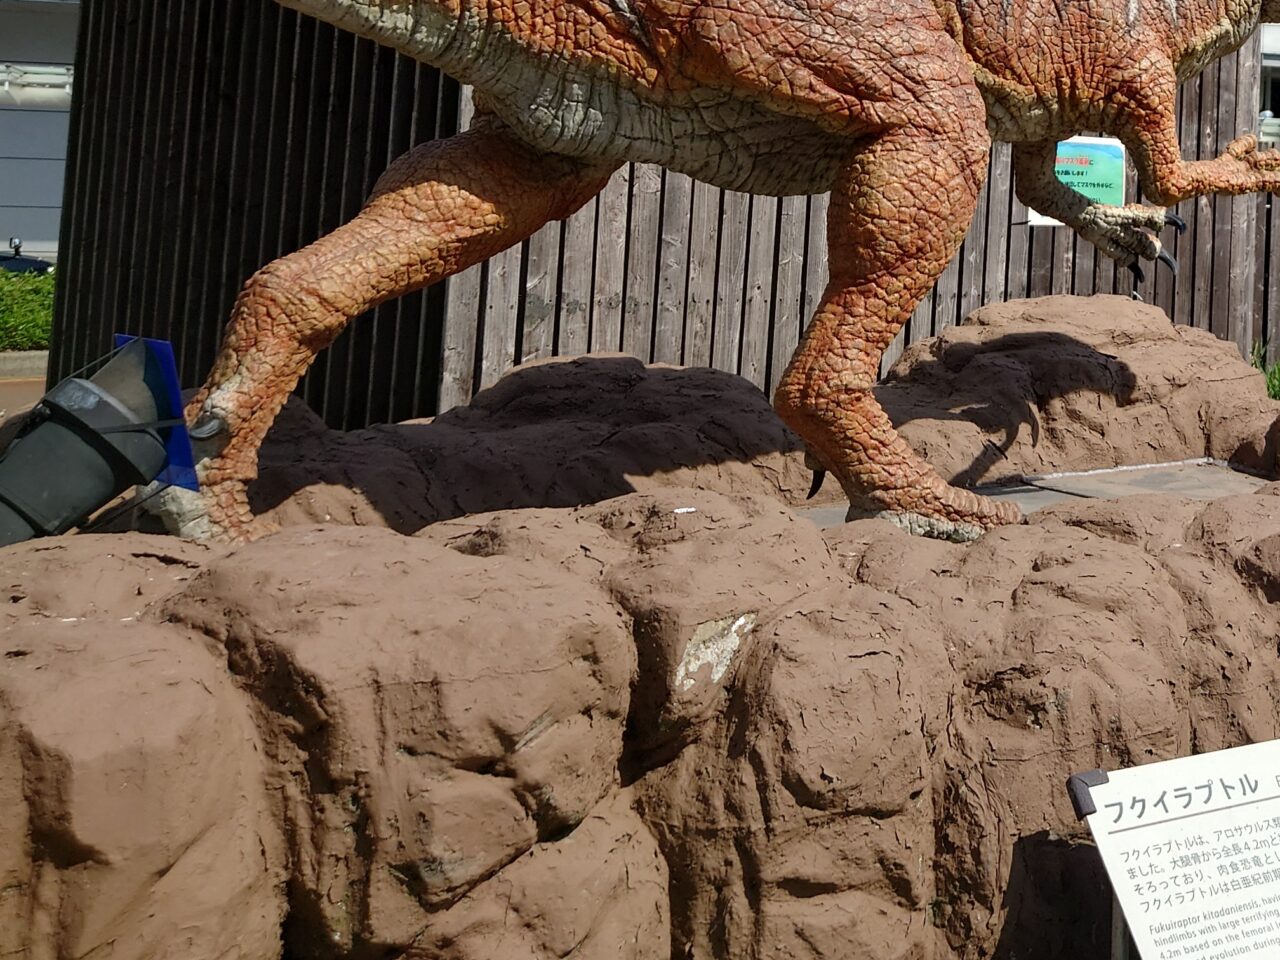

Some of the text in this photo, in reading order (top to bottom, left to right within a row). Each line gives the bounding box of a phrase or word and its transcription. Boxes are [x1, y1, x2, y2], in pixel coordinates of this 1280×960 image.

[1103, 773, 1259, 825] フクイラプトル
[1149, 916, 1200, 935] Fukuiraptor
[1154, 930, 1196, 947] hindlimbs
[1198, 924, 1217, 935] with
[1218, 920, 1240, 930] large
[1242, 909, 1280, 924] terrifying
[1160, 949, 1181, 960] 4.2m
[1183, 940, 1210, 954] based
[1241, 923, 1274, 938] femoral
[1209, 946, 1251, 960] evolution
[1253, 938, 1280, 950] during
